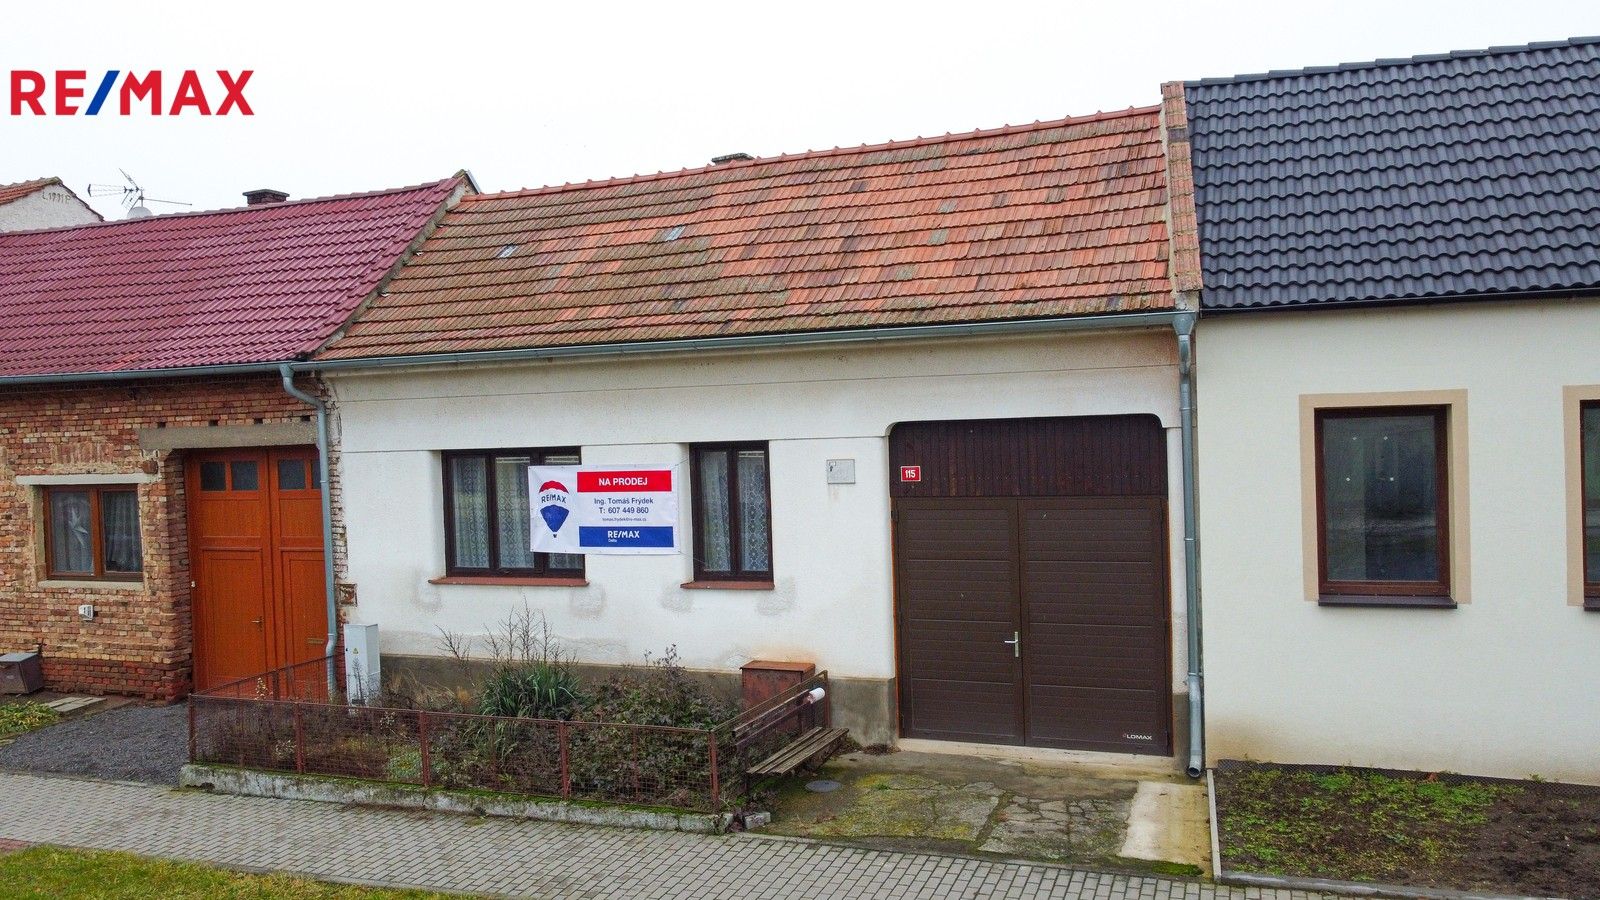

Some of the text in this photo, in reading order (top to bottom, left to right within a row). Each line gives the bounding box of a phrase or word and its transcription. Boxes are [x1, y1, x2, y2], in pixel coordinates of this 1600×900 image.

[905, 469, 916, 479] 115
[598, 477, 648, 486] NA PRODEJ
[541, 493, 567, 504] RE/MAX
[631, 497, 654, 505] Frýdek
[608, 506, 621, 514] 607
[622, 506, 635, 514] 449
[636, 506, 649, 514] 860
[607, 530, 640, 539] RE/MAX
